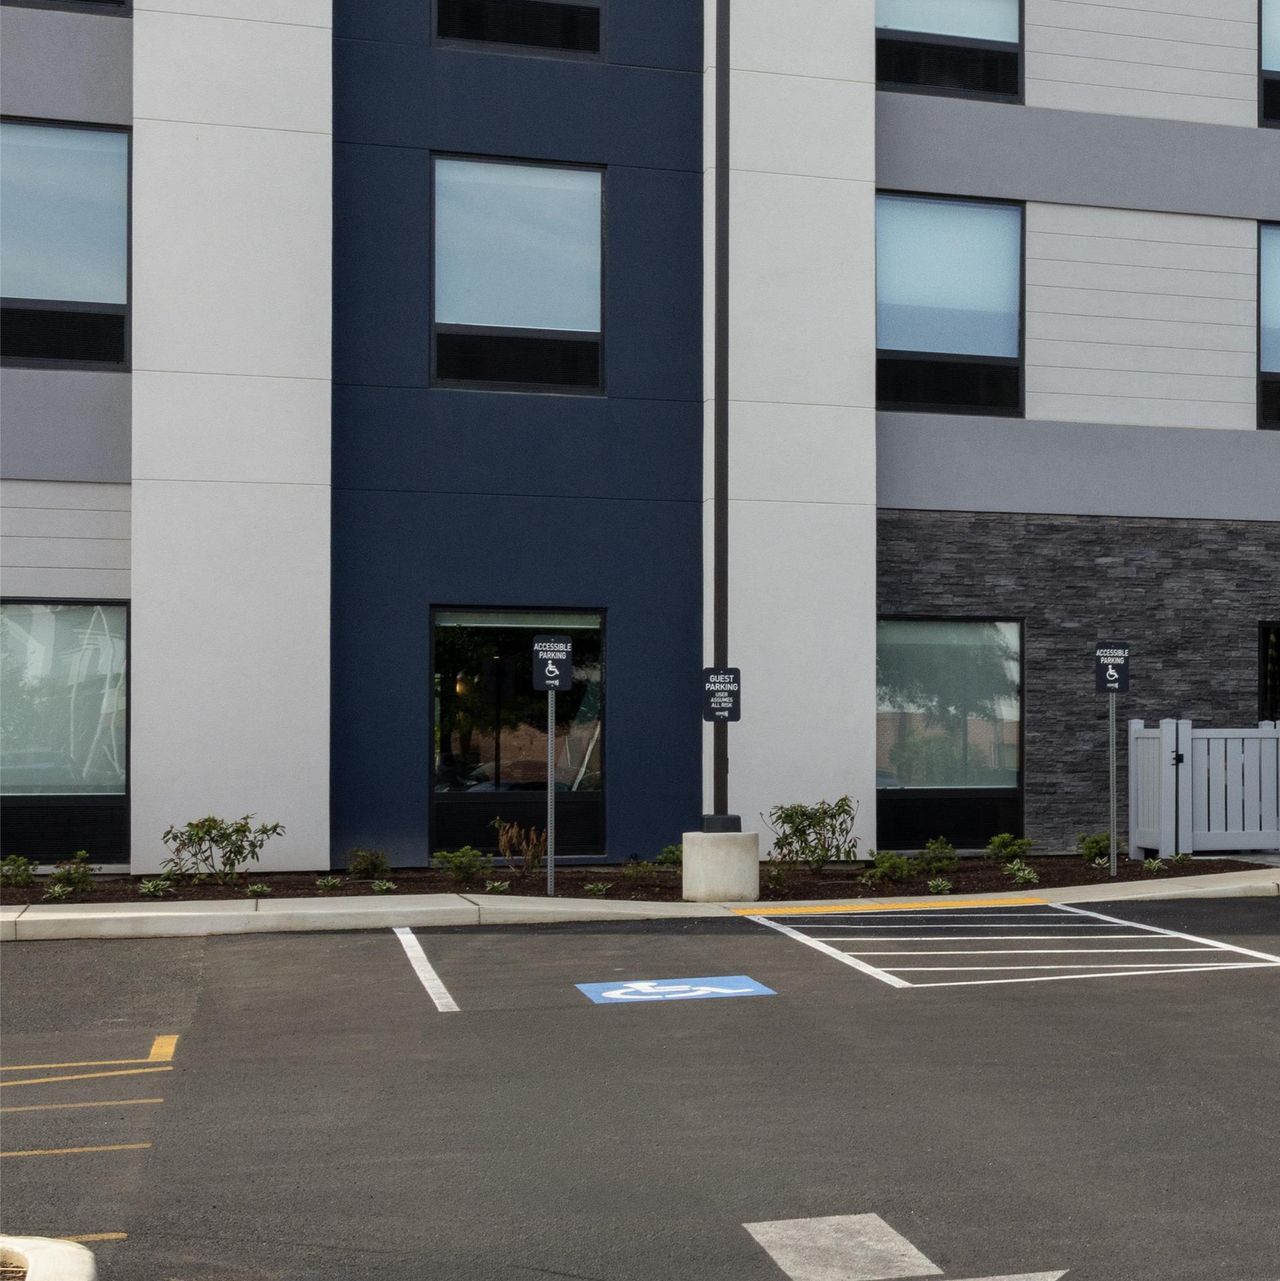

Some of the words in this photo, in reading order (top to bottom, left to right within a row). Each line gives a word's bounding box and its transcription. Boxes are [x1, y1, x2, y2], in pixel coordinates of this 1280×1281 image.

[534, 643, 572, 651] ACCESSIBLE
[539, 651, 566, 659] PARKING
[1096, 649, 1129, 657] ACCESSIBLE
[1100, 657, 1124, 665] PARKING
[709, 674, 734, 683] GUEST
[705, 683, 738, 691] PARKING
